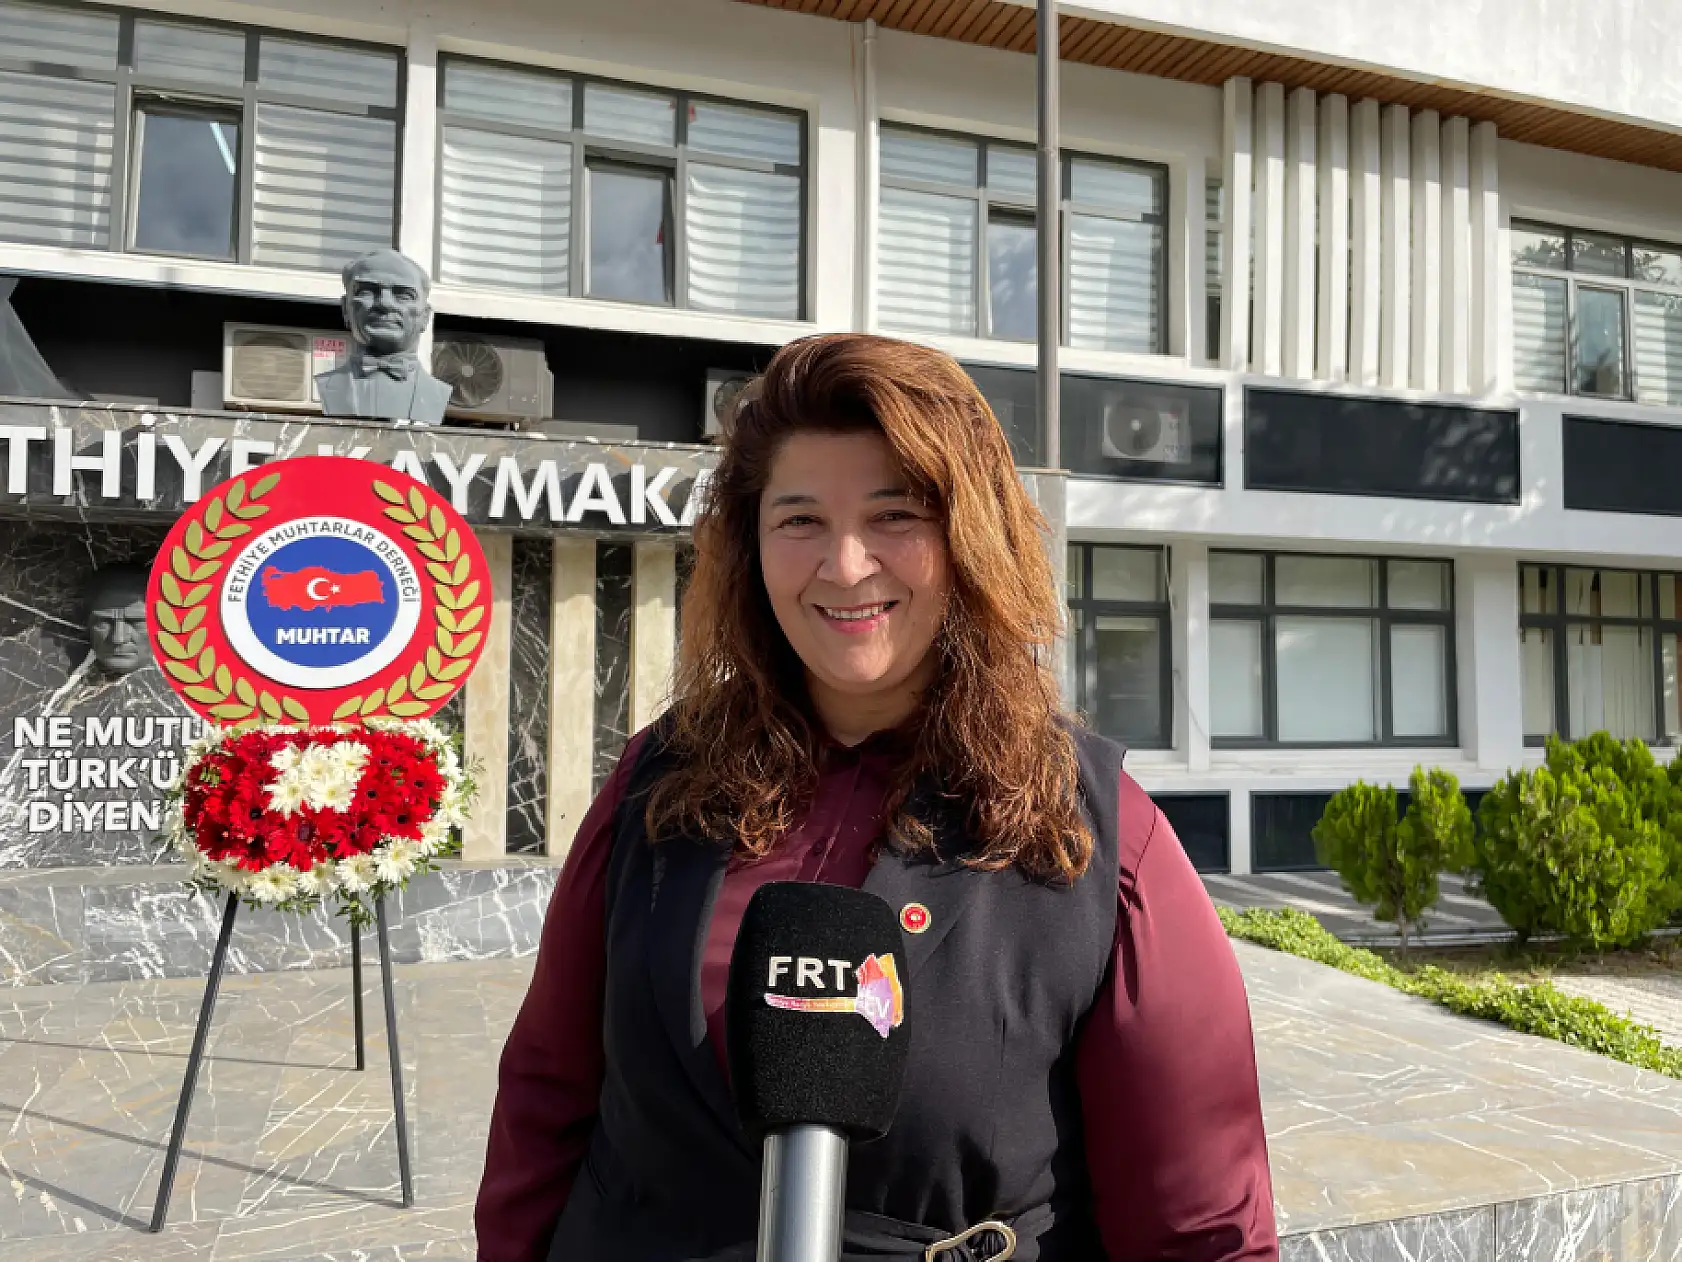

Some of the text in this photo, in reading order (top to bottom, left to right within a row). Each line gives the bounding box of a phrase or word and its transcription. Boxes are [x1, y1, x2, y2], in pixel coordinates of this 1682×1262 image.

[318, 445, 715, 526] YMAK
[268, 521, 375, 547] MUHTARLAR
[276, 627, 370, 644] MUHTAR
[14, 716, 73, 748] NE
[29, 793, 160, 832] DİYEN
[768, 956, 852, 991] FRT
